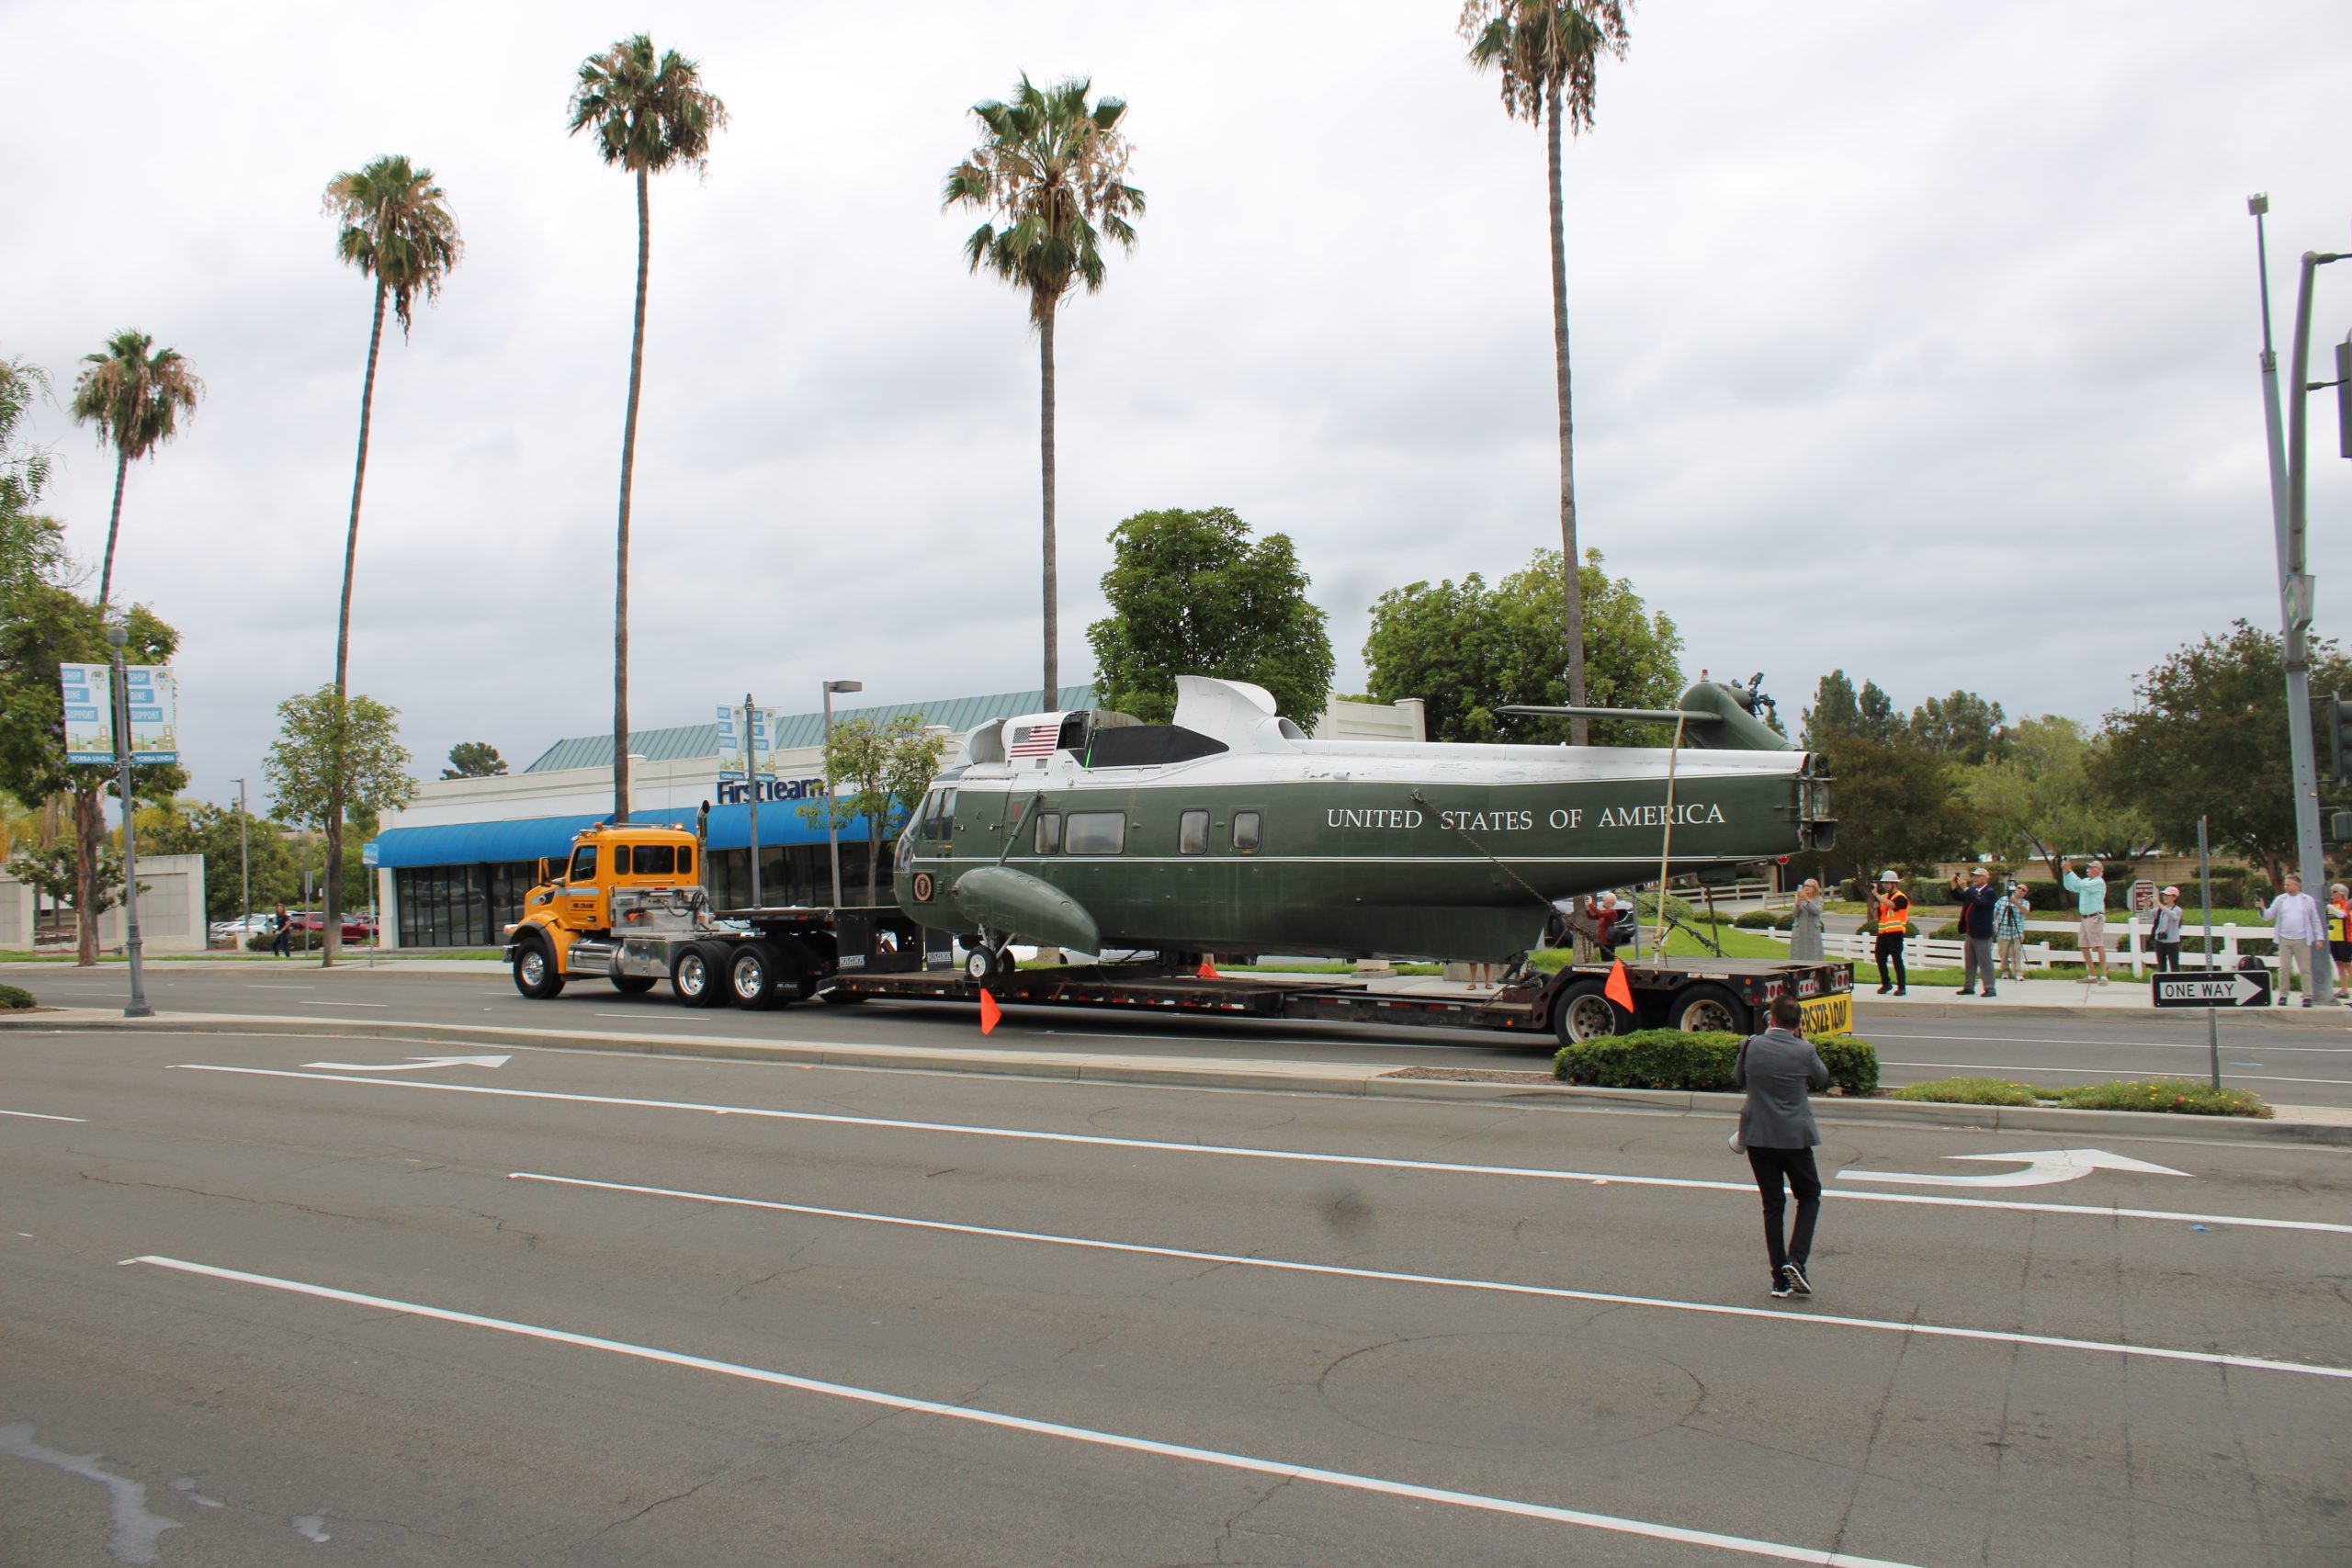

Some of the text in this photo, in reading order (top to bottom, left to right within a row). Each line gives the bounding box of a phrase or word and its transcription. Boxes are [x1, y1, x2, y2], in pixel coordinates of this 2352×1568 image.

[62, 671, 82, 681] SHOP
[129, 672, 147, 682] SHOP
[64, 690, 82, 700] DINE
[130, 692, 147, 701] DINE
[66, 710, 96, 719] SUPPORT
[131, 710, 160, 720] SUPPORT
[1327, 803, 1726, 831] UNITED STATES OF AMERICA
[840, 955, 865, 966] MAGNA
[927, 952, 952, 962] MAGNA
[2165, 983, 2234, 998] ONE WAY
